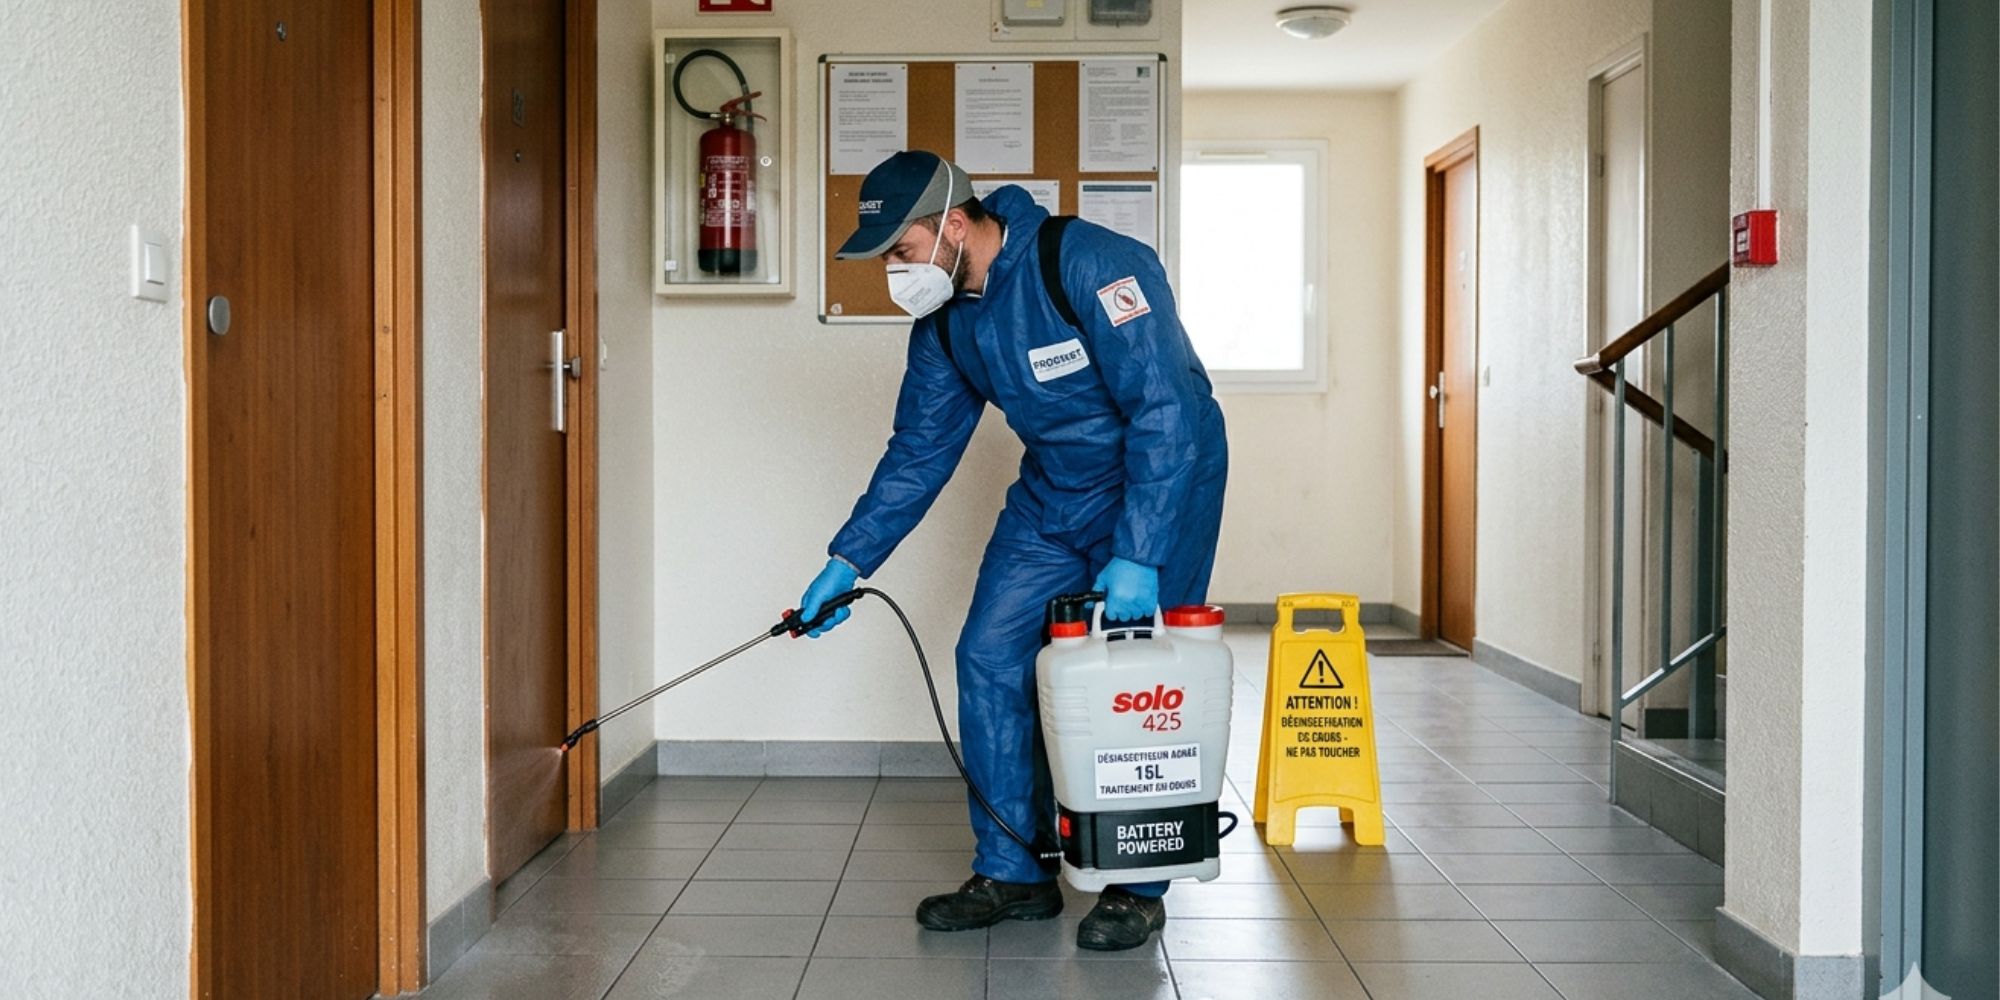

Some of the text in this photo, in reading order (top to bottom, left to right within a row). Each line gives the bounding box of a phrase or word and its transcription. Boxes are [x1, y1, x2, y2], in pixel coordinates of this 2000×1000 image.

[1112, 684, 1184, 713] solo
[1286, 695, 1358, 709] ATTENTION !
[1142, 712, 1182, 731] 425
[1300, 746, 1316, 758] PAS
[1319, 746, 1360, 757] TOUCHER
[1135, 764, 1164, 780] 15L
[1100, 783, 1154, 795] TRAITEMENT
[1117, 820, 1184, 839] BATTERY
[1117, 837, 1184, 855] POWERED
